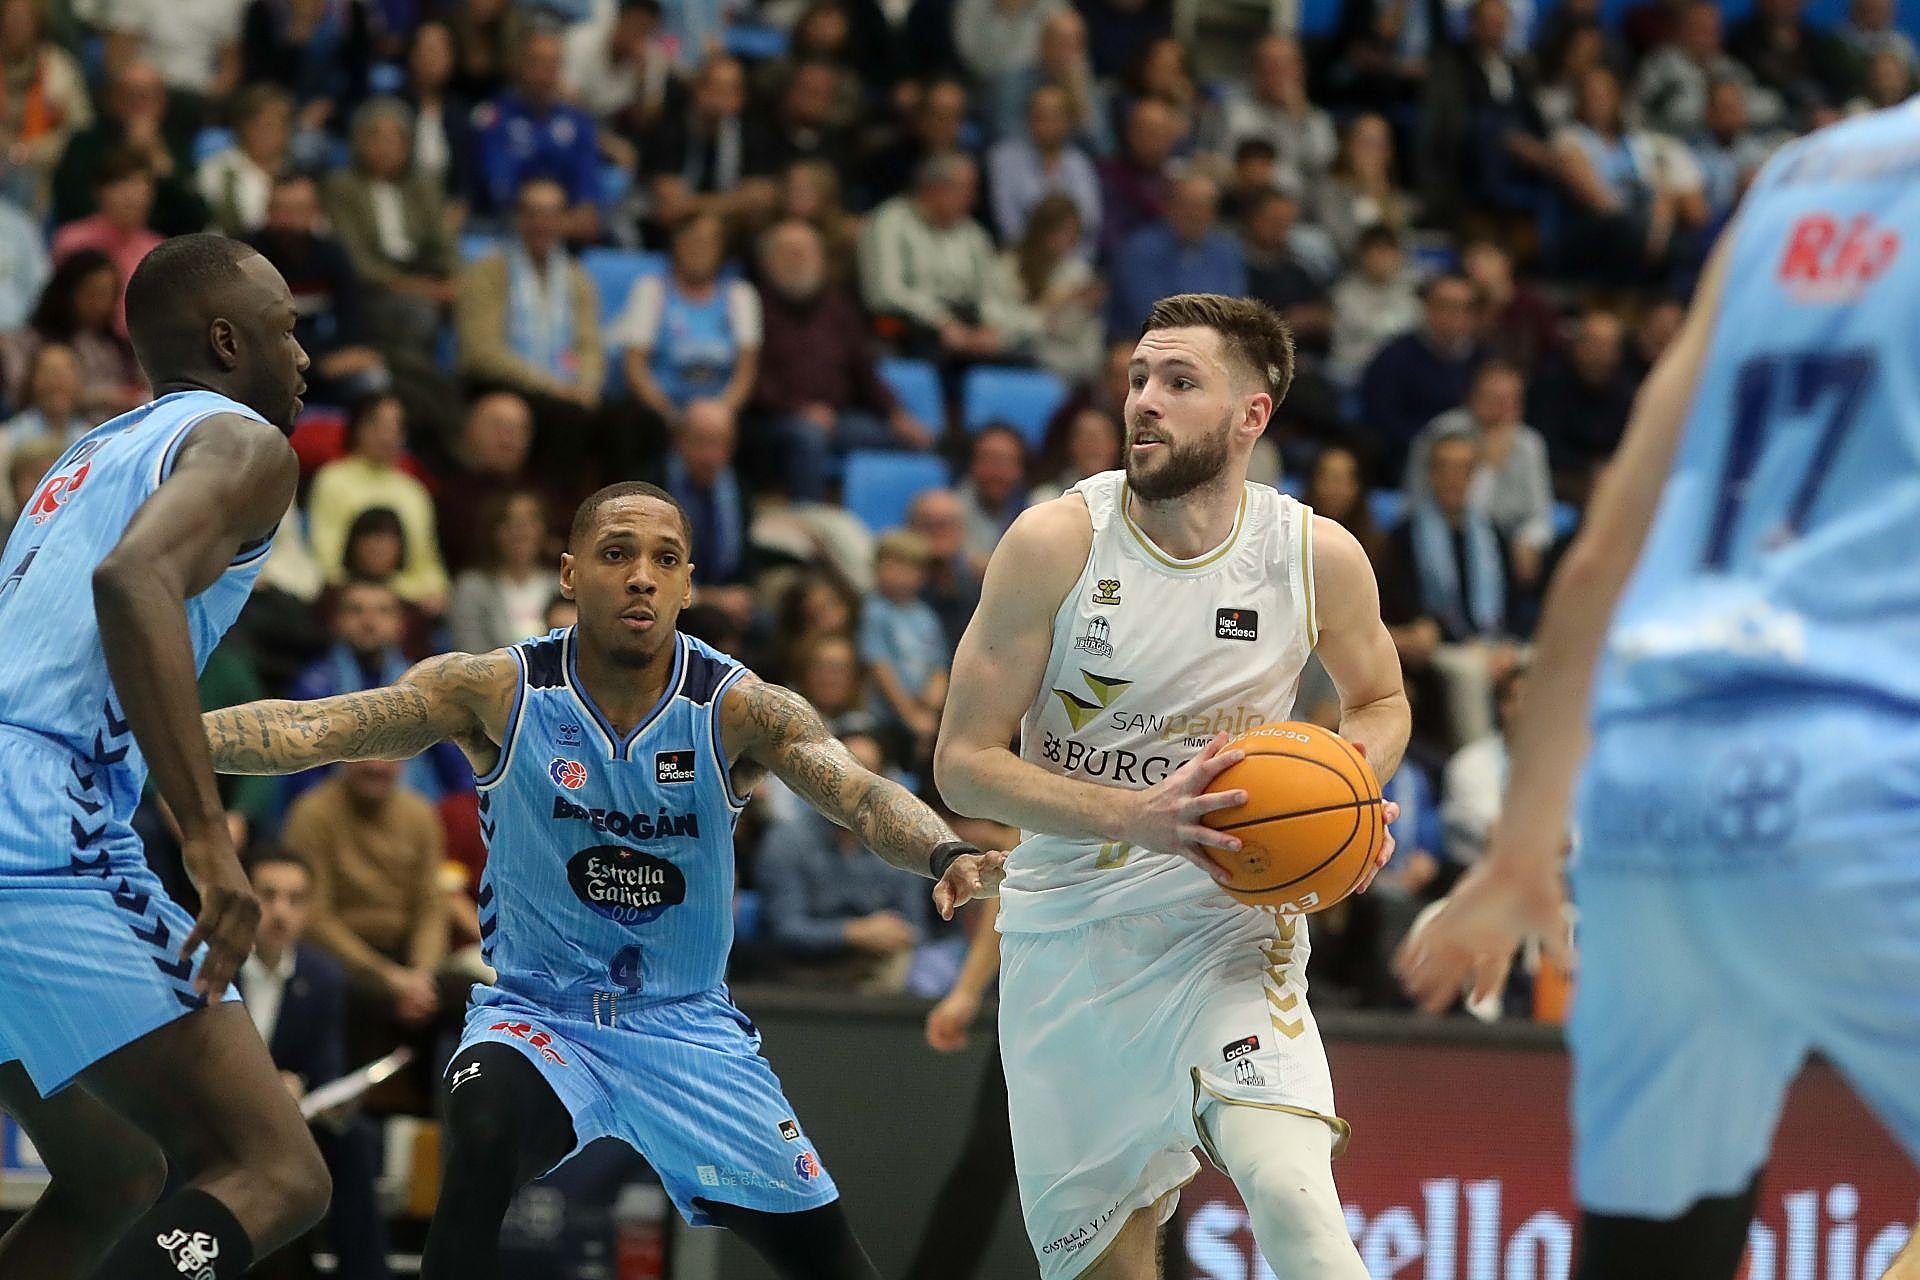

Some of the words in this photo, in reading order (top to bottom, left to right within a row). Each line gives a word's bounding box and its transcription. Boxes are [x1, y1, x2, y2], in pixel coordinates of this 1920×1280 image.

[1219, 616, 1237, 628] liga
[1219, 627, 1256, 638] endesa
[555, 738, 581, 748] hummel
[659, 761, 677, 772] liga
[585, 856, 665, 886] Estrella
[587, 878, 662, 908] Galicia
[608, 943, 644, 995] 4
[1226, 1044, 1253, 1060] acb
[1042, 1227, 1088, 1255] CASTILLA
[1089, 1218, 1100, 1232] Y
